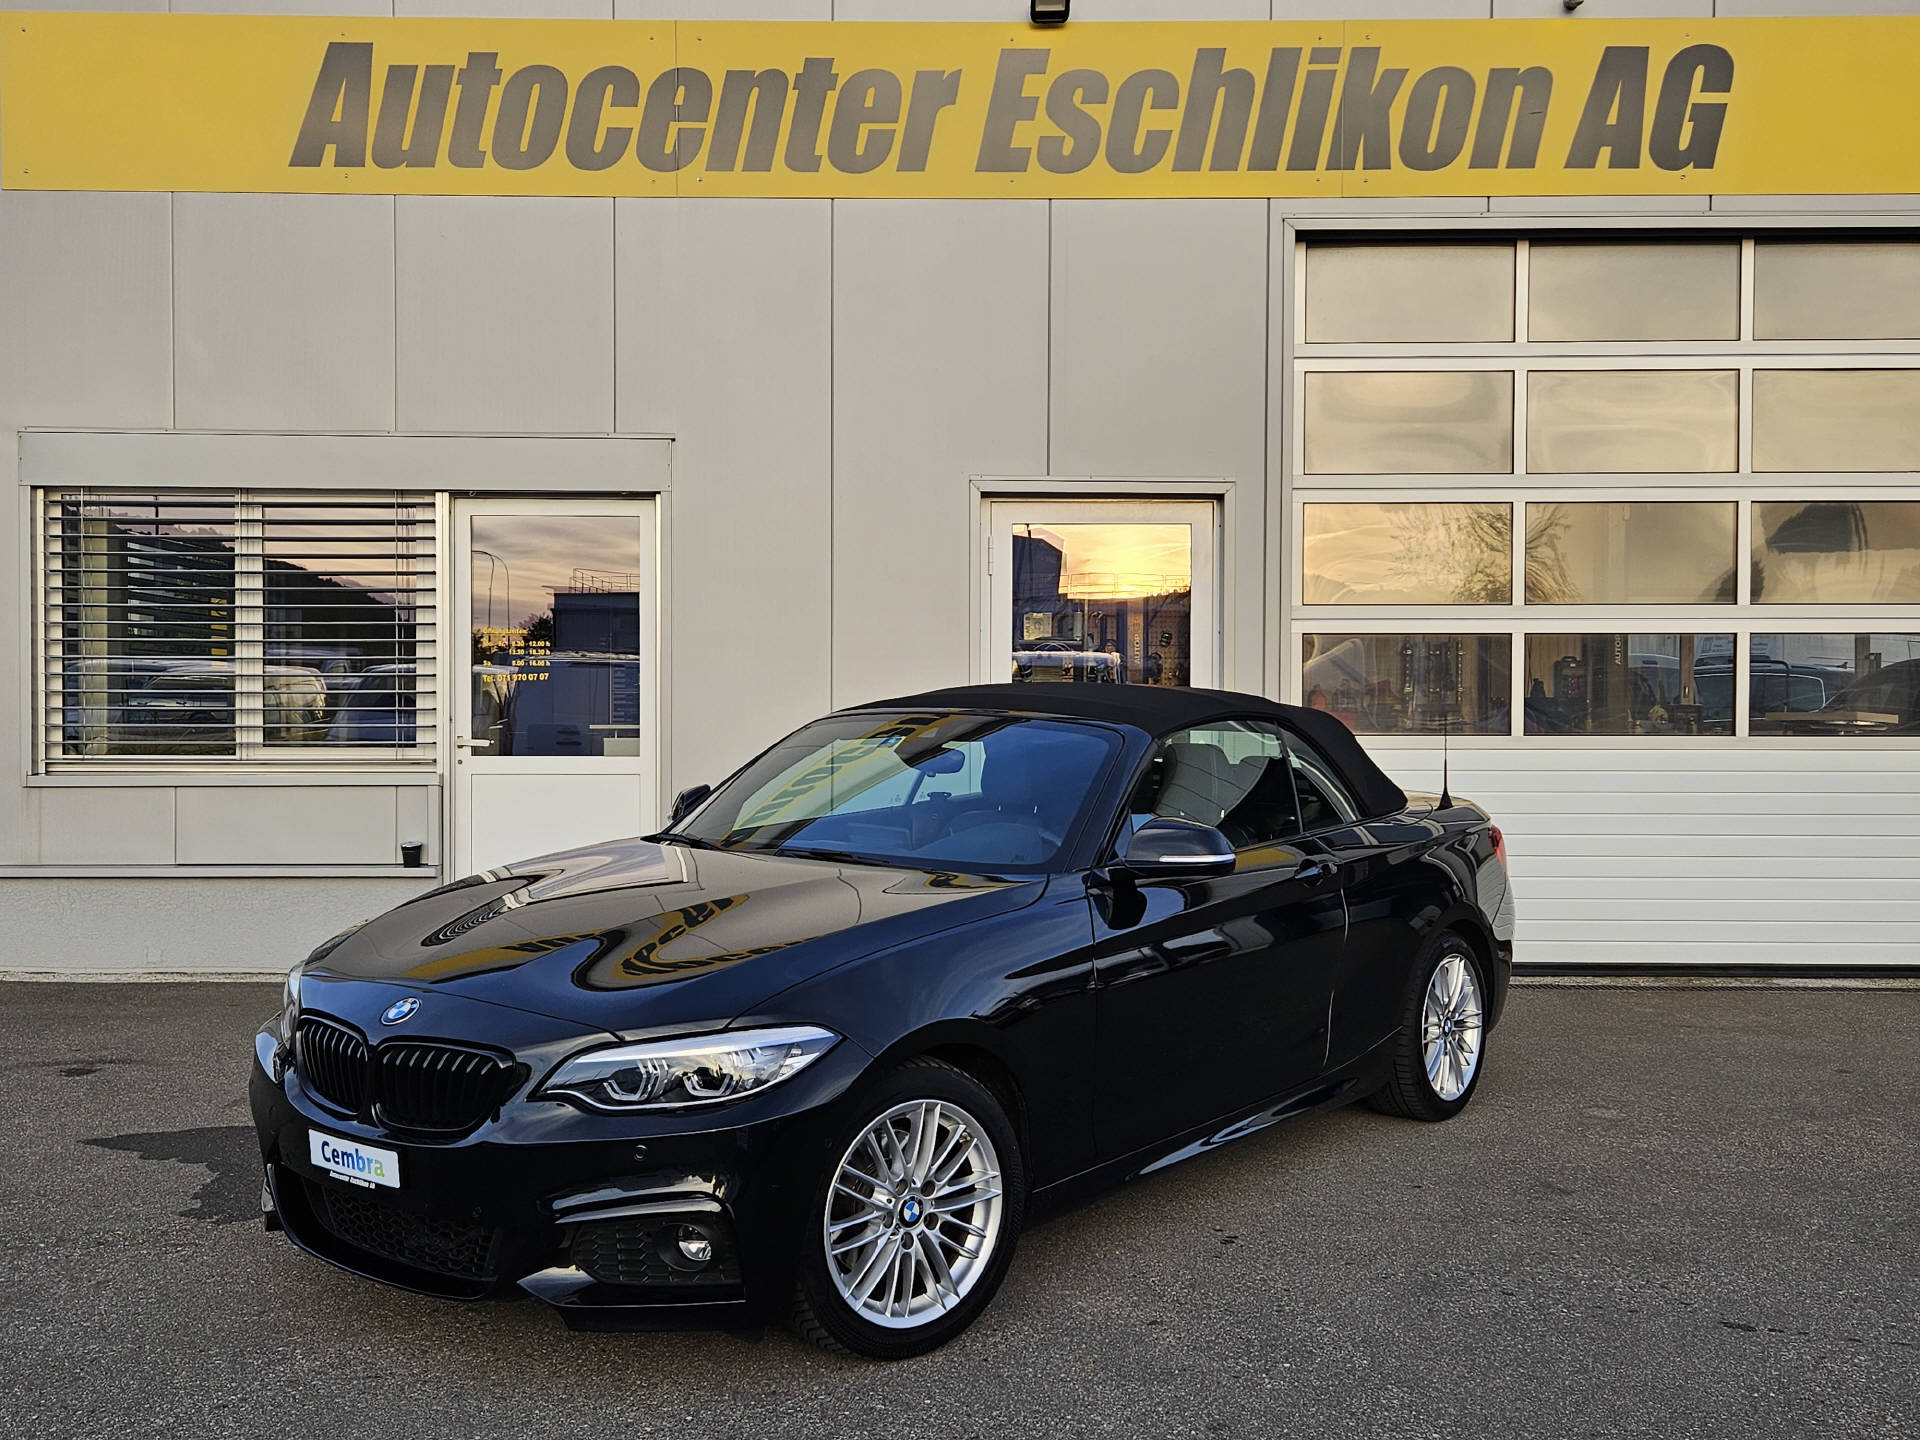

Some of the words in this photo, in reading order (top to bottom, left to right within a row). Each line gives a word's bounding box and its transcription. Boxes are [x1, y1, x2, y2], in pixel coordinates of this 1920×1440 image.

[288, 42, 963, 173] Autocenter
[974, 46, 1554, 173] Eschlikon
[1562, 43, 1735, 172] AG
[513, 673, 527, 681] 970
[528, 673, 538, 681] 07
[539, 672, 549, 680] 07
[321, 1140, 385, 1178] Cembra
